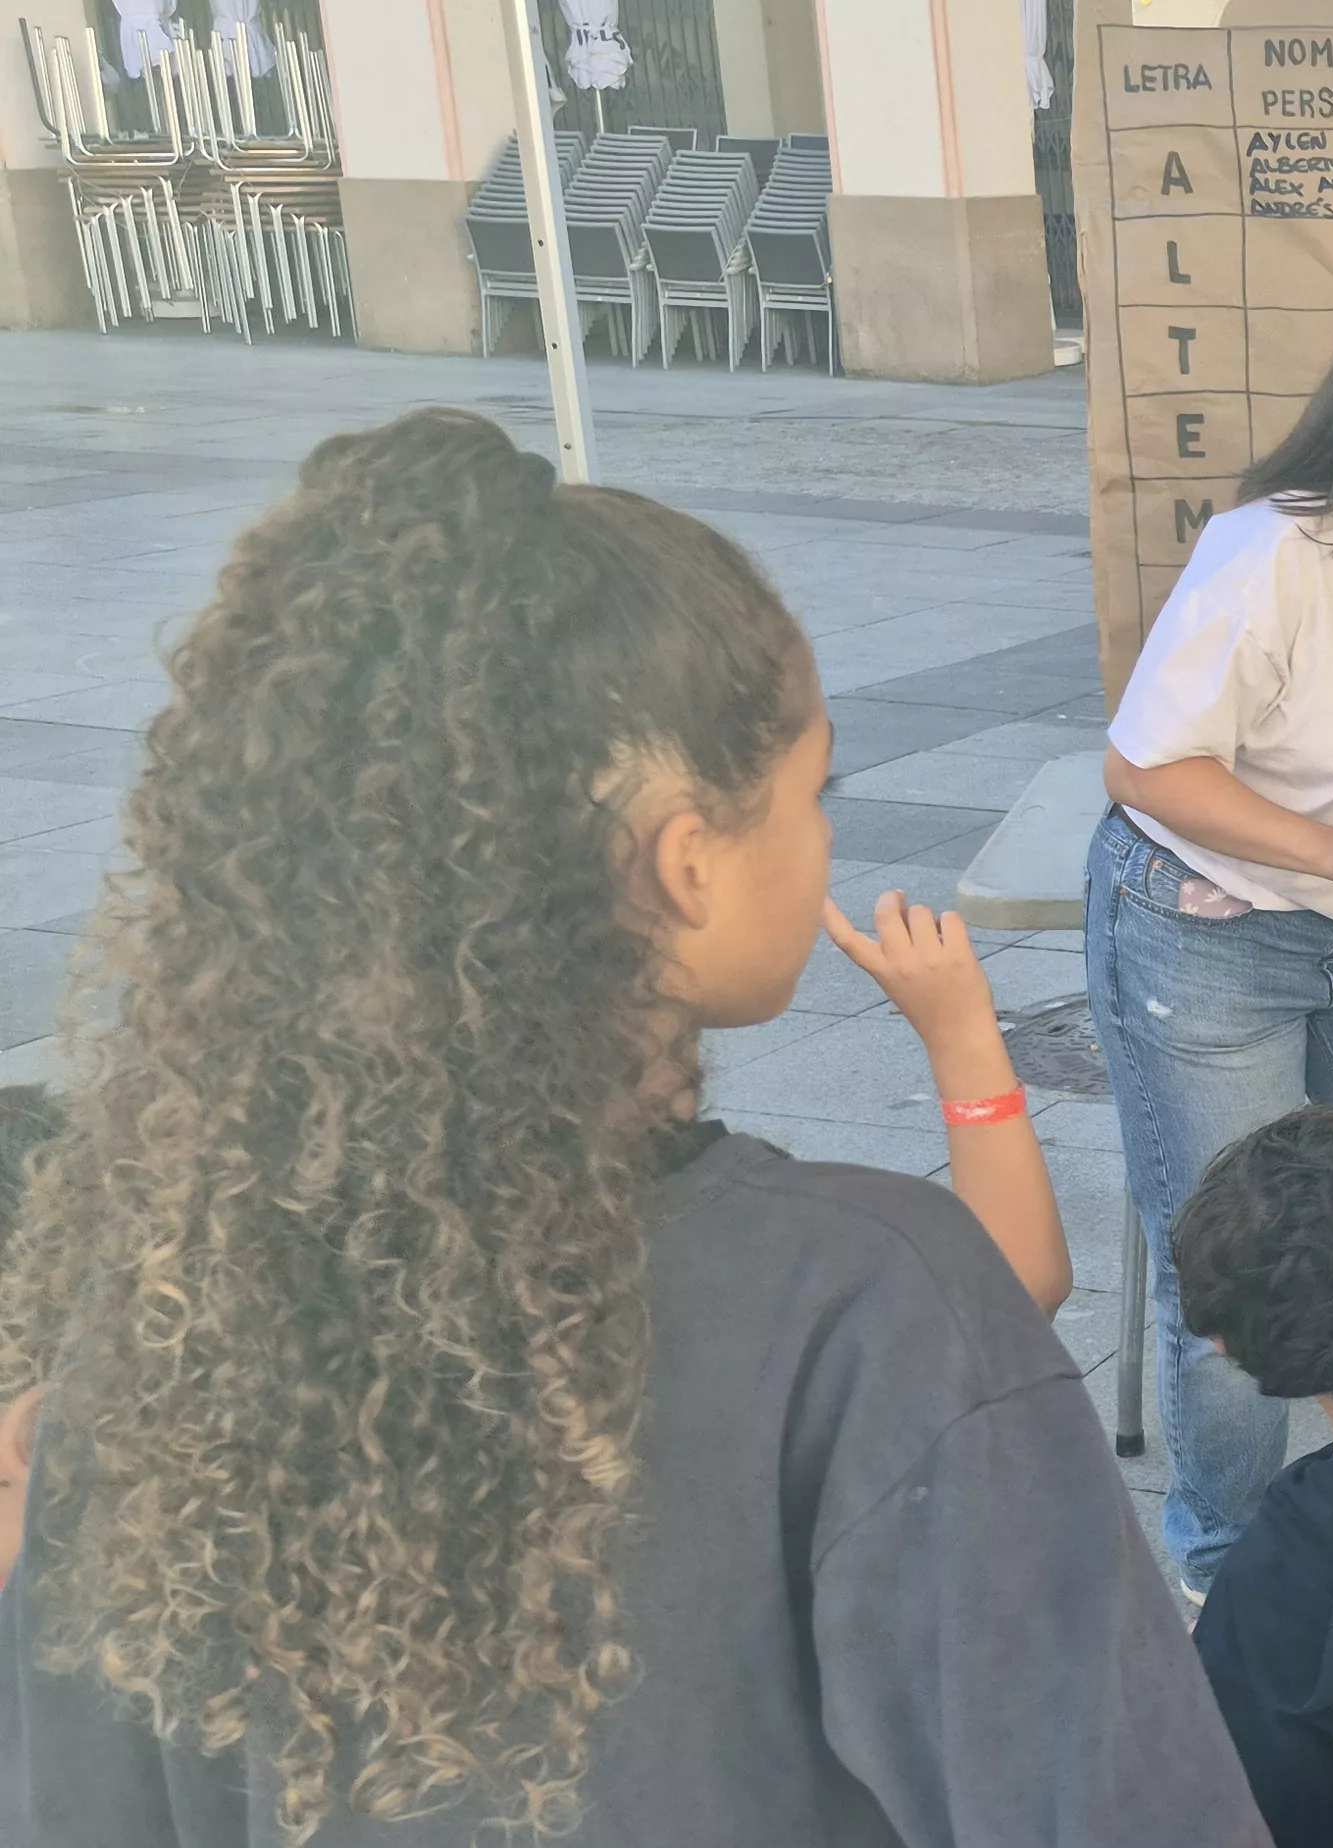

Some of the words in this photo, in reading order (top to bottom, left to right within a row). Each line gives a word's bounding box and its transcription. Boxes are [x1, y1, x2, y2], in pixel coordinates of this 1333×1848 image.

[1123, 63, 1212, 93] LETRA
[1160, 151, 1194, 195] A
[1249, 175, 1304, 197] ALEX
[1166, 240, 1192, 284] L
[1168, 326, 1196, 375] T
[1176, 414, 1206, 458] E
